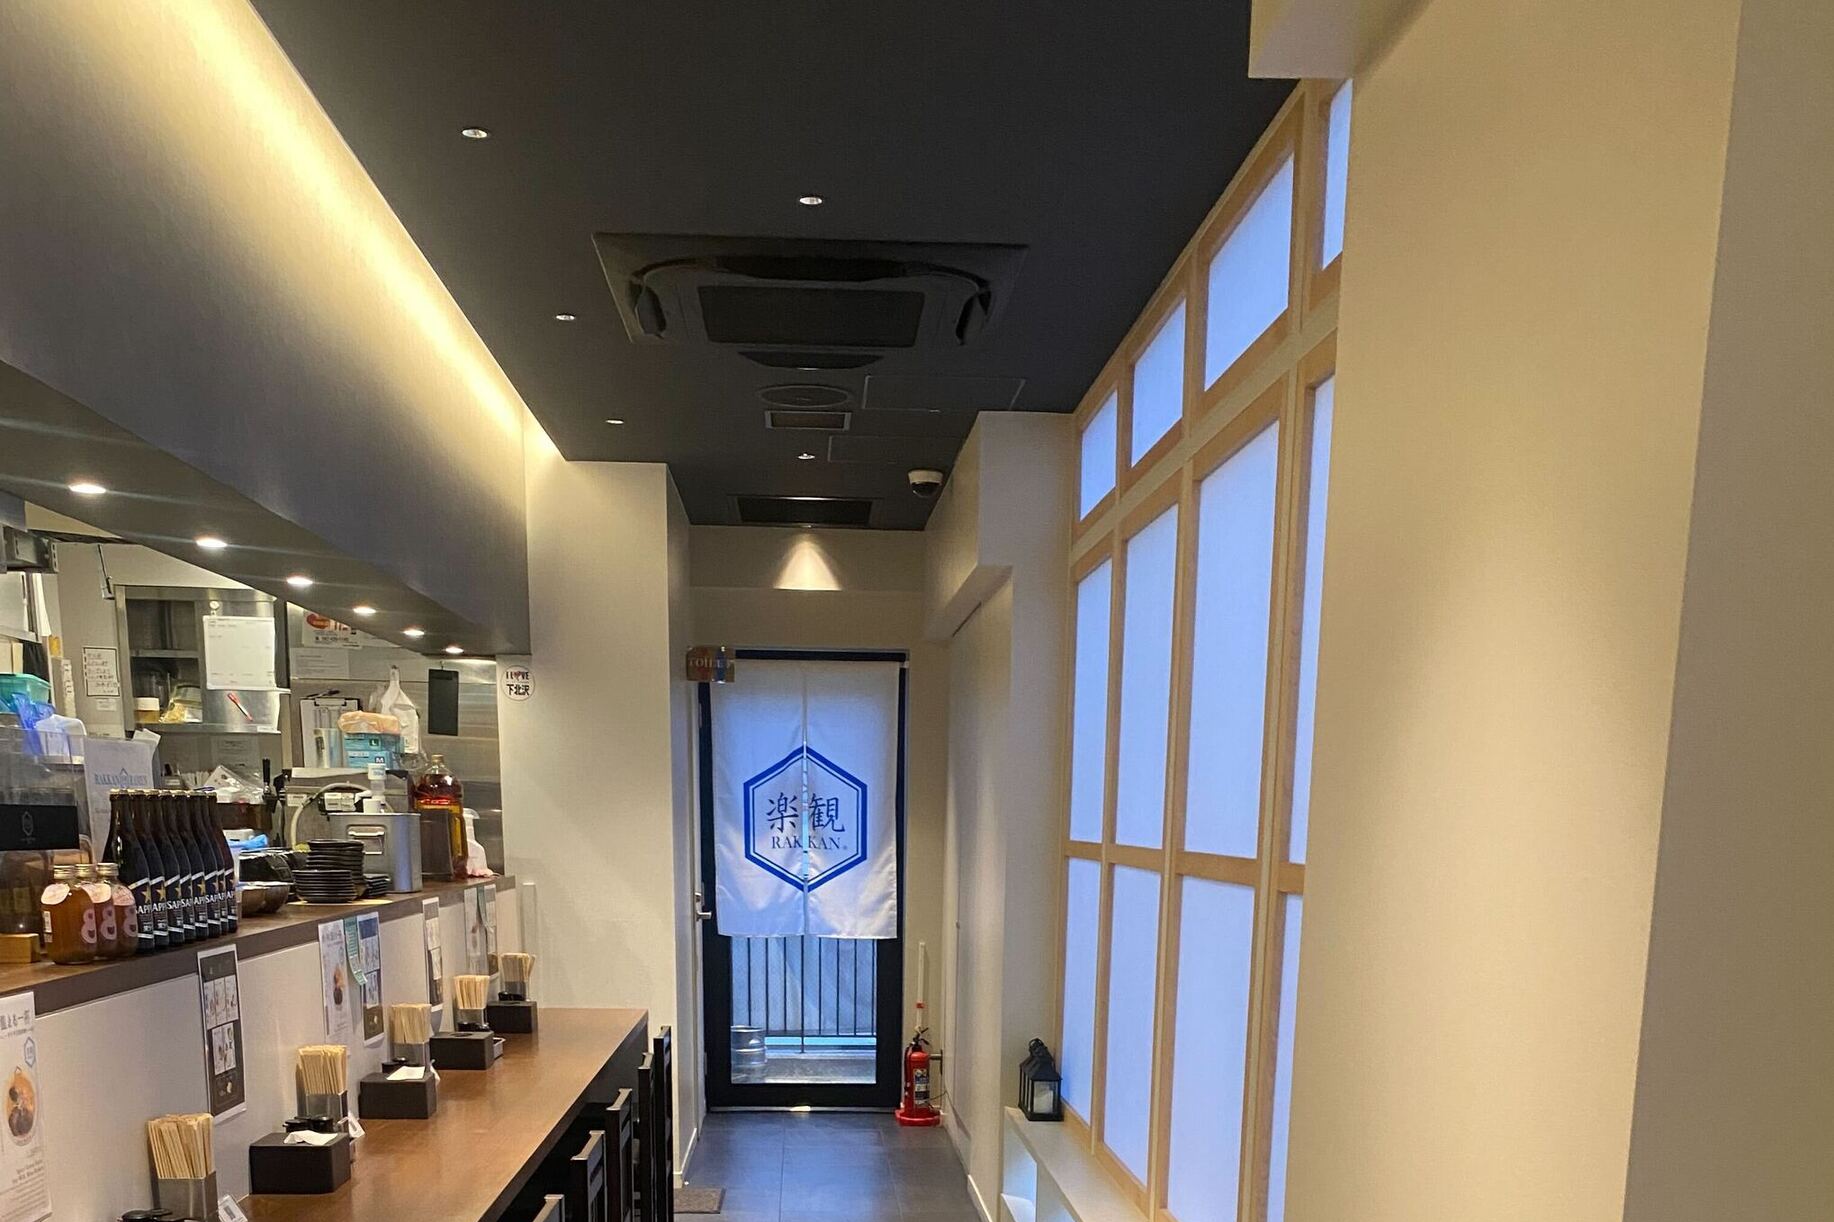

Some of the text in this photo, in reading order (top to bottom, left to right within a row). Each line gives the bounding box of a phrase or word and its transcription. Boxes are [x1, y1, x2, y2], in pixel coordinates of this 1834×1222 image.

[506, 683, 530, 696] 下北沢
[766, 792, 846, 833] 楽観
[772, 835, 840, 850] RAKKAN
